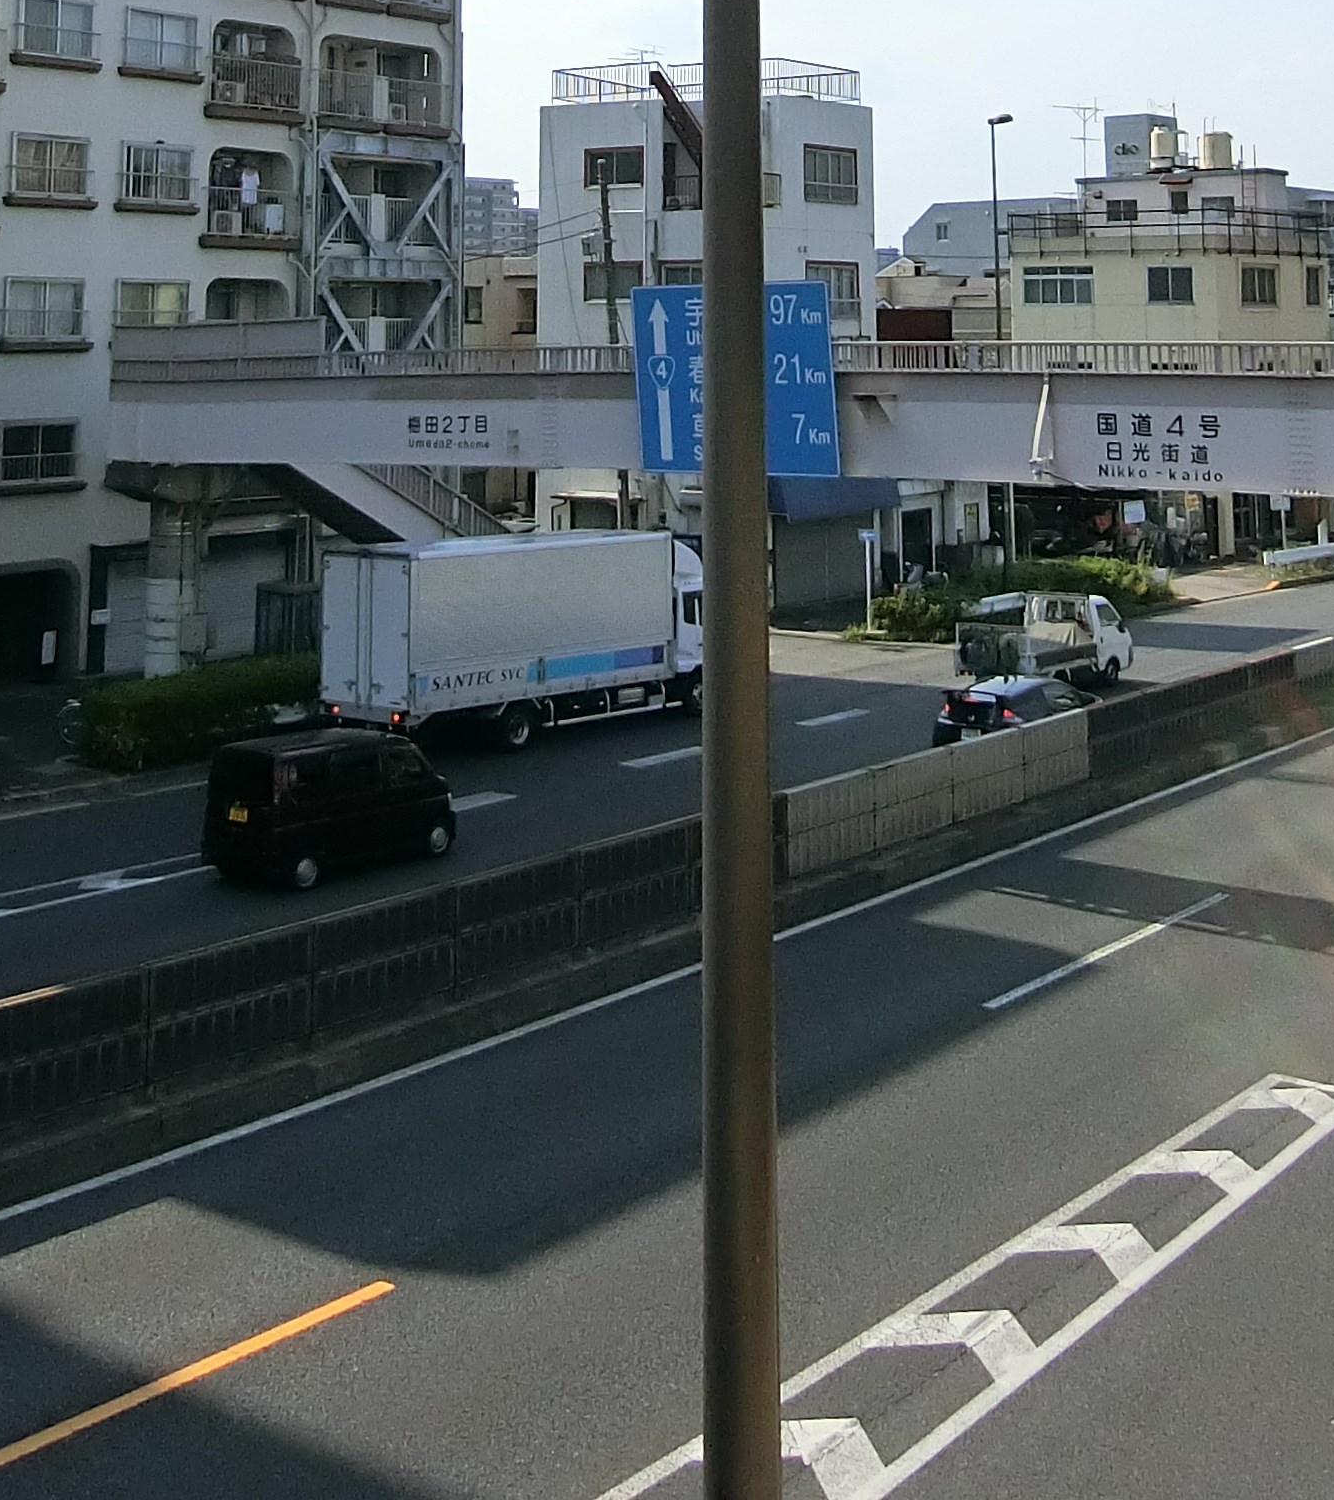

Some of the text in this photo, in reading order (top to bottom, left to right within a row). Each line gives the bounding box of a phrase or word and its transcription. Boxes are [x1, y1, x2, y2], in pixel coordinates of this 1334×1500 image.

[770, 294, 797, 325] 97
[655, 360, 667, 380] 4
[773, 353, 802, 385] 21
[791, 413, 806, 445] 7
[1106, 441, 1210, 465] 日光街道
[430, 665, 526, 692] SANTEC SVC
